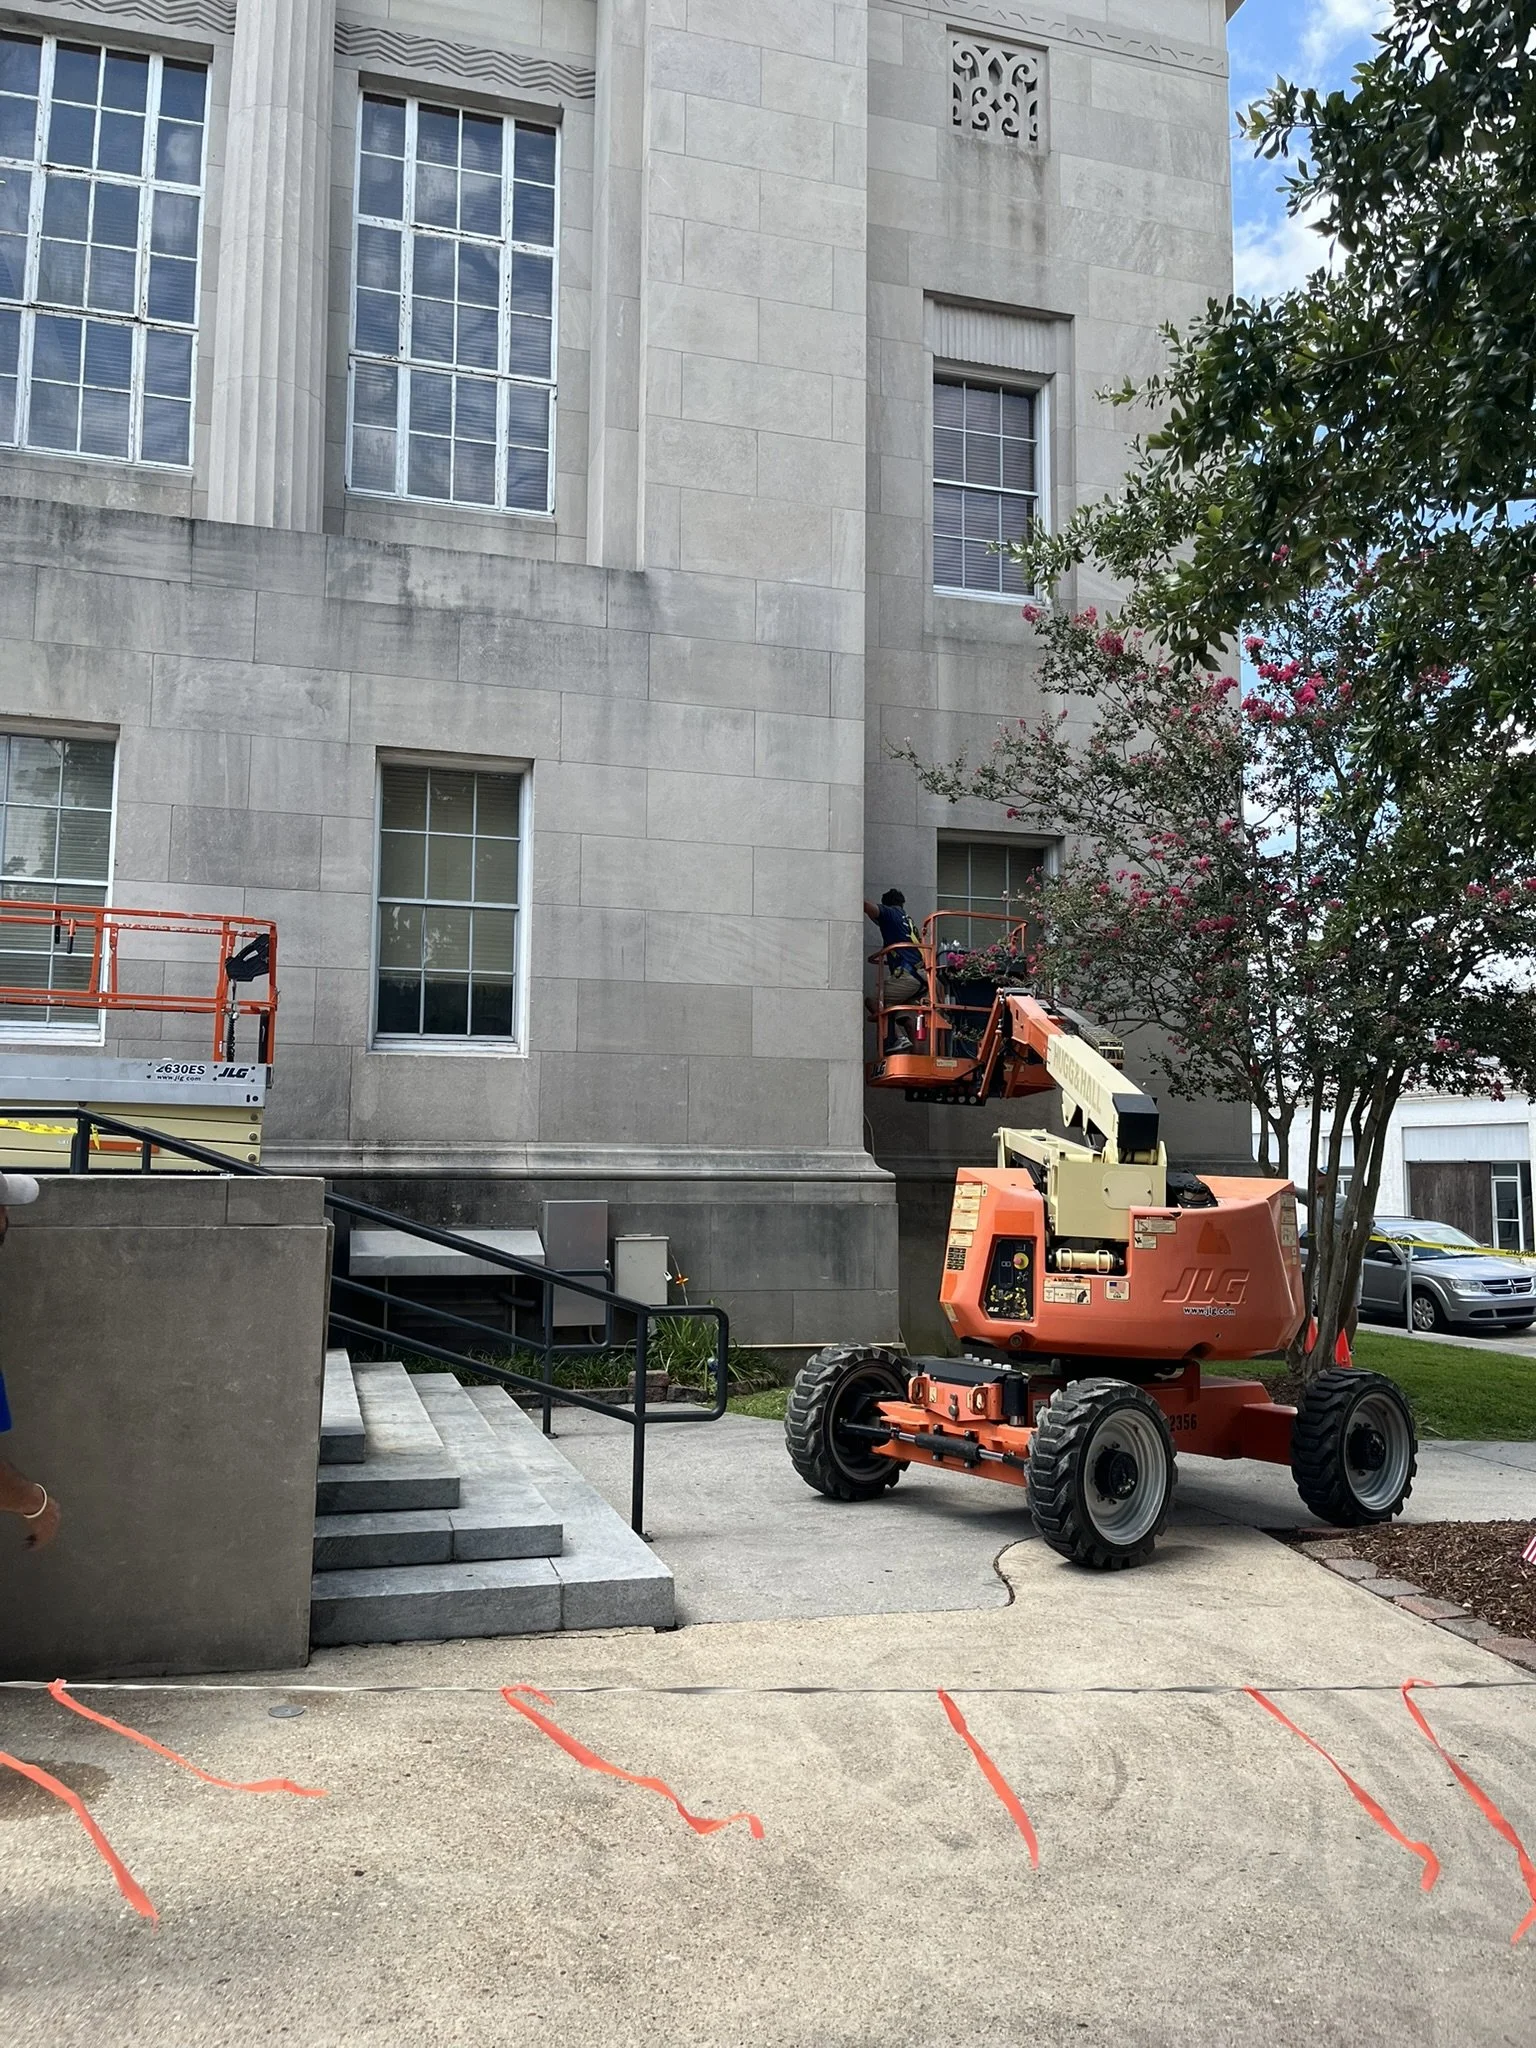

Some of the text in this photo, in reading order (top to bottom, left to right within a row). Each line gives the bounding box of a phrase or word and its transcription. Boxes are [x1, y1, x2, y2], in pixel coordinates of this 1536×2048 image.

[156, 1064, 205, 1075] 2630ES
[218, 1068, 249, 1078] JLG
[1161, 1267, 1250, 1305] JLG
[1183, 1307, 1236, 1316] www.jlg.com
[1169, 1413, 1198, 1432] 2356
